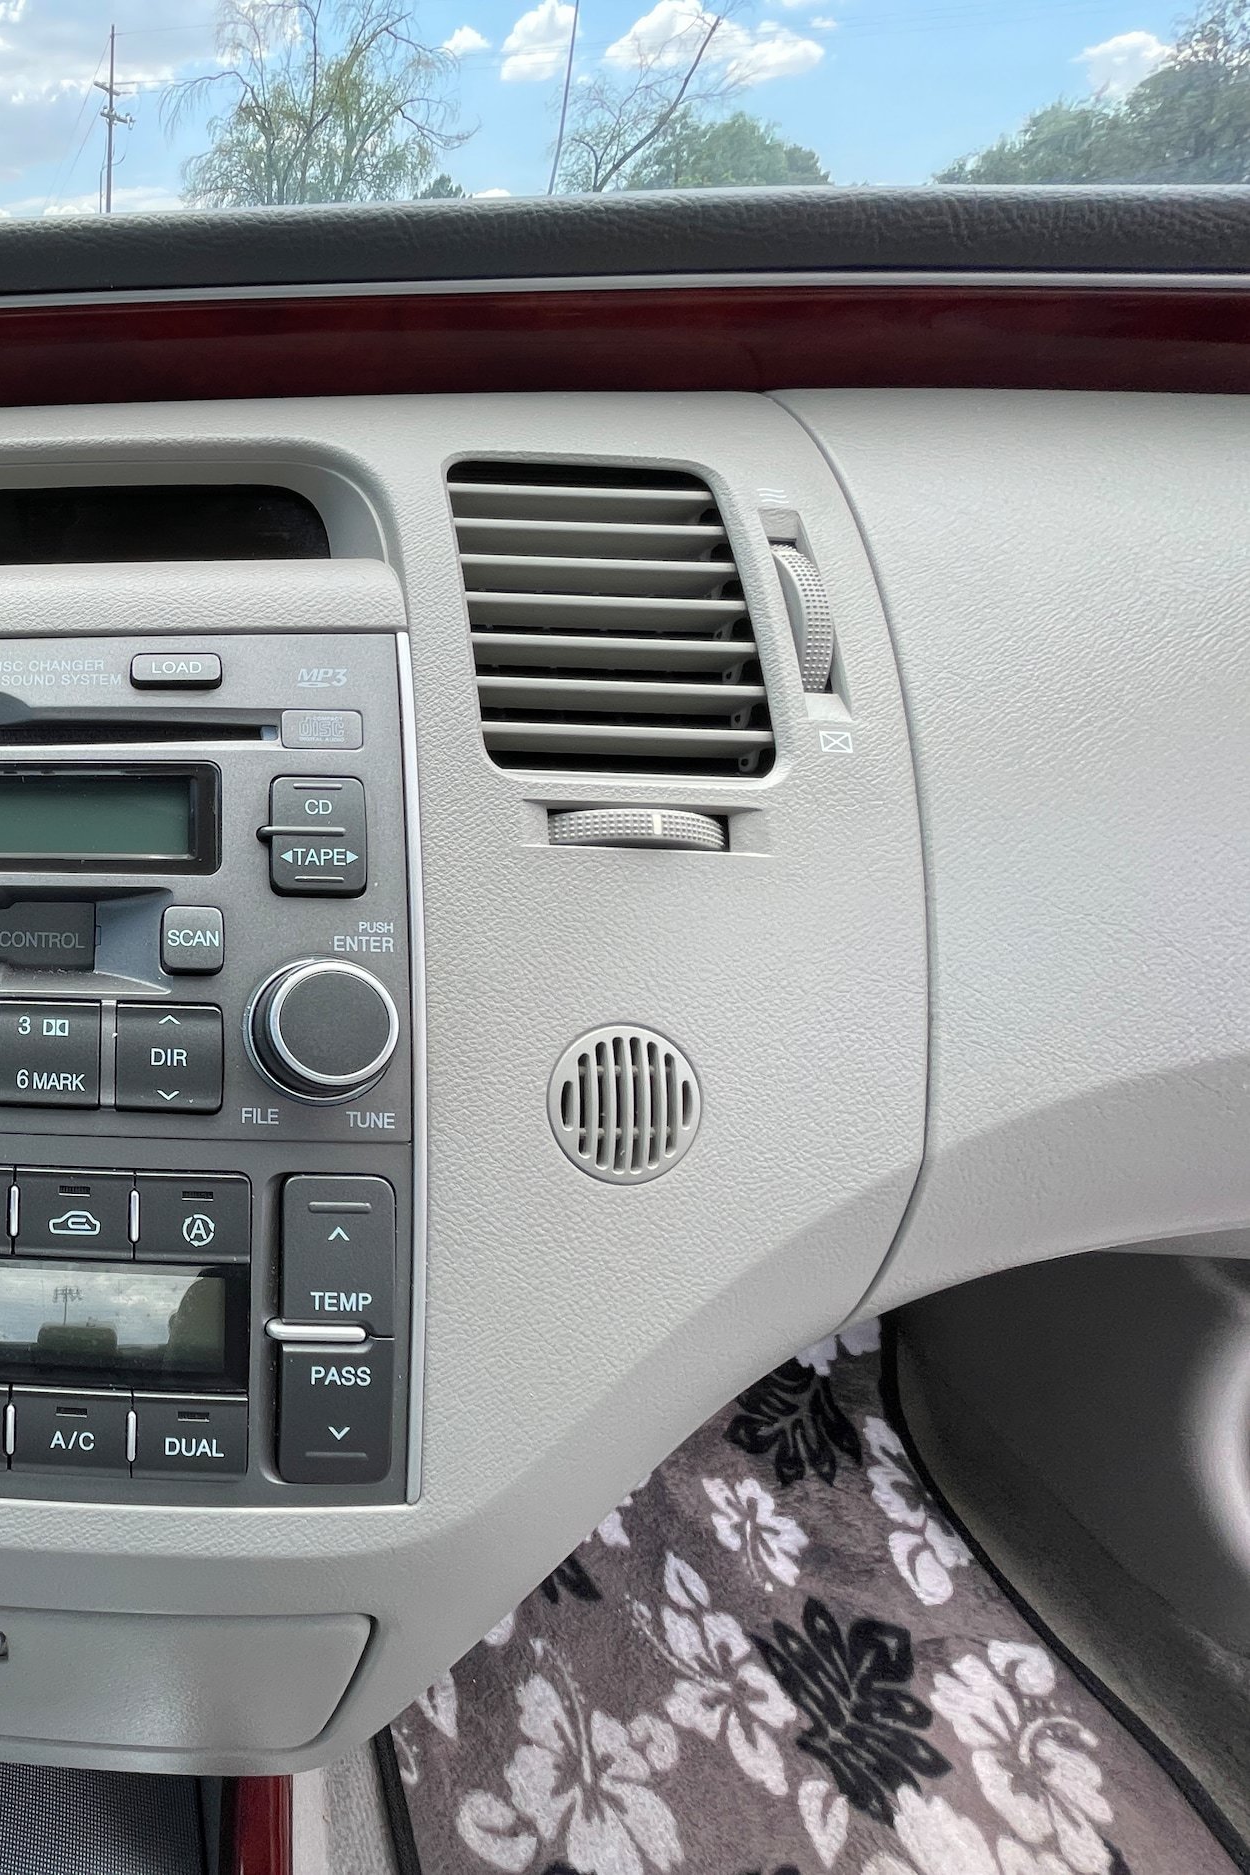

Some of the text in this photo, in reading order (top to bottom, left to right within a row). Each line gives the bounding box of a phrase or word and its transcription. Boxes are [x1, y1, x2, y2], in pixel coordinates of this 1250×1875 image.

[29, 660, 105, 672] CHANGER
[151, 661, 202, 674] LOAD
[1, 675, 56, 686] SOUND
[61, 674, 122, 686] SYSTEM
[297, 668, 348, 687] MP3
[304, 800, 332, 815] CD
[293, 849, 346, 866] TAPE
[358, 922, 394, 934] PUSH
[0, 931, 85, 949] CONTROL
[167, 930, 219, 947] SCAN
[333, 937, 394, 953] ENTER
[18, 1016, 31, 1034] 3
[150, 1049, 187, 1067] DIR
[16, 1069, 85, 1091] 6 MARK
[241, 1108, 279, 1125] FILE
[347, 1112, 395, 1129] TUNE
[310, 1292, 372, 1312] TEMP
[310, 1367, 371, 1386] PASS
[50, 1431, 95, 1451] A/C
[165, 1438, 224, 1458] DUAL
